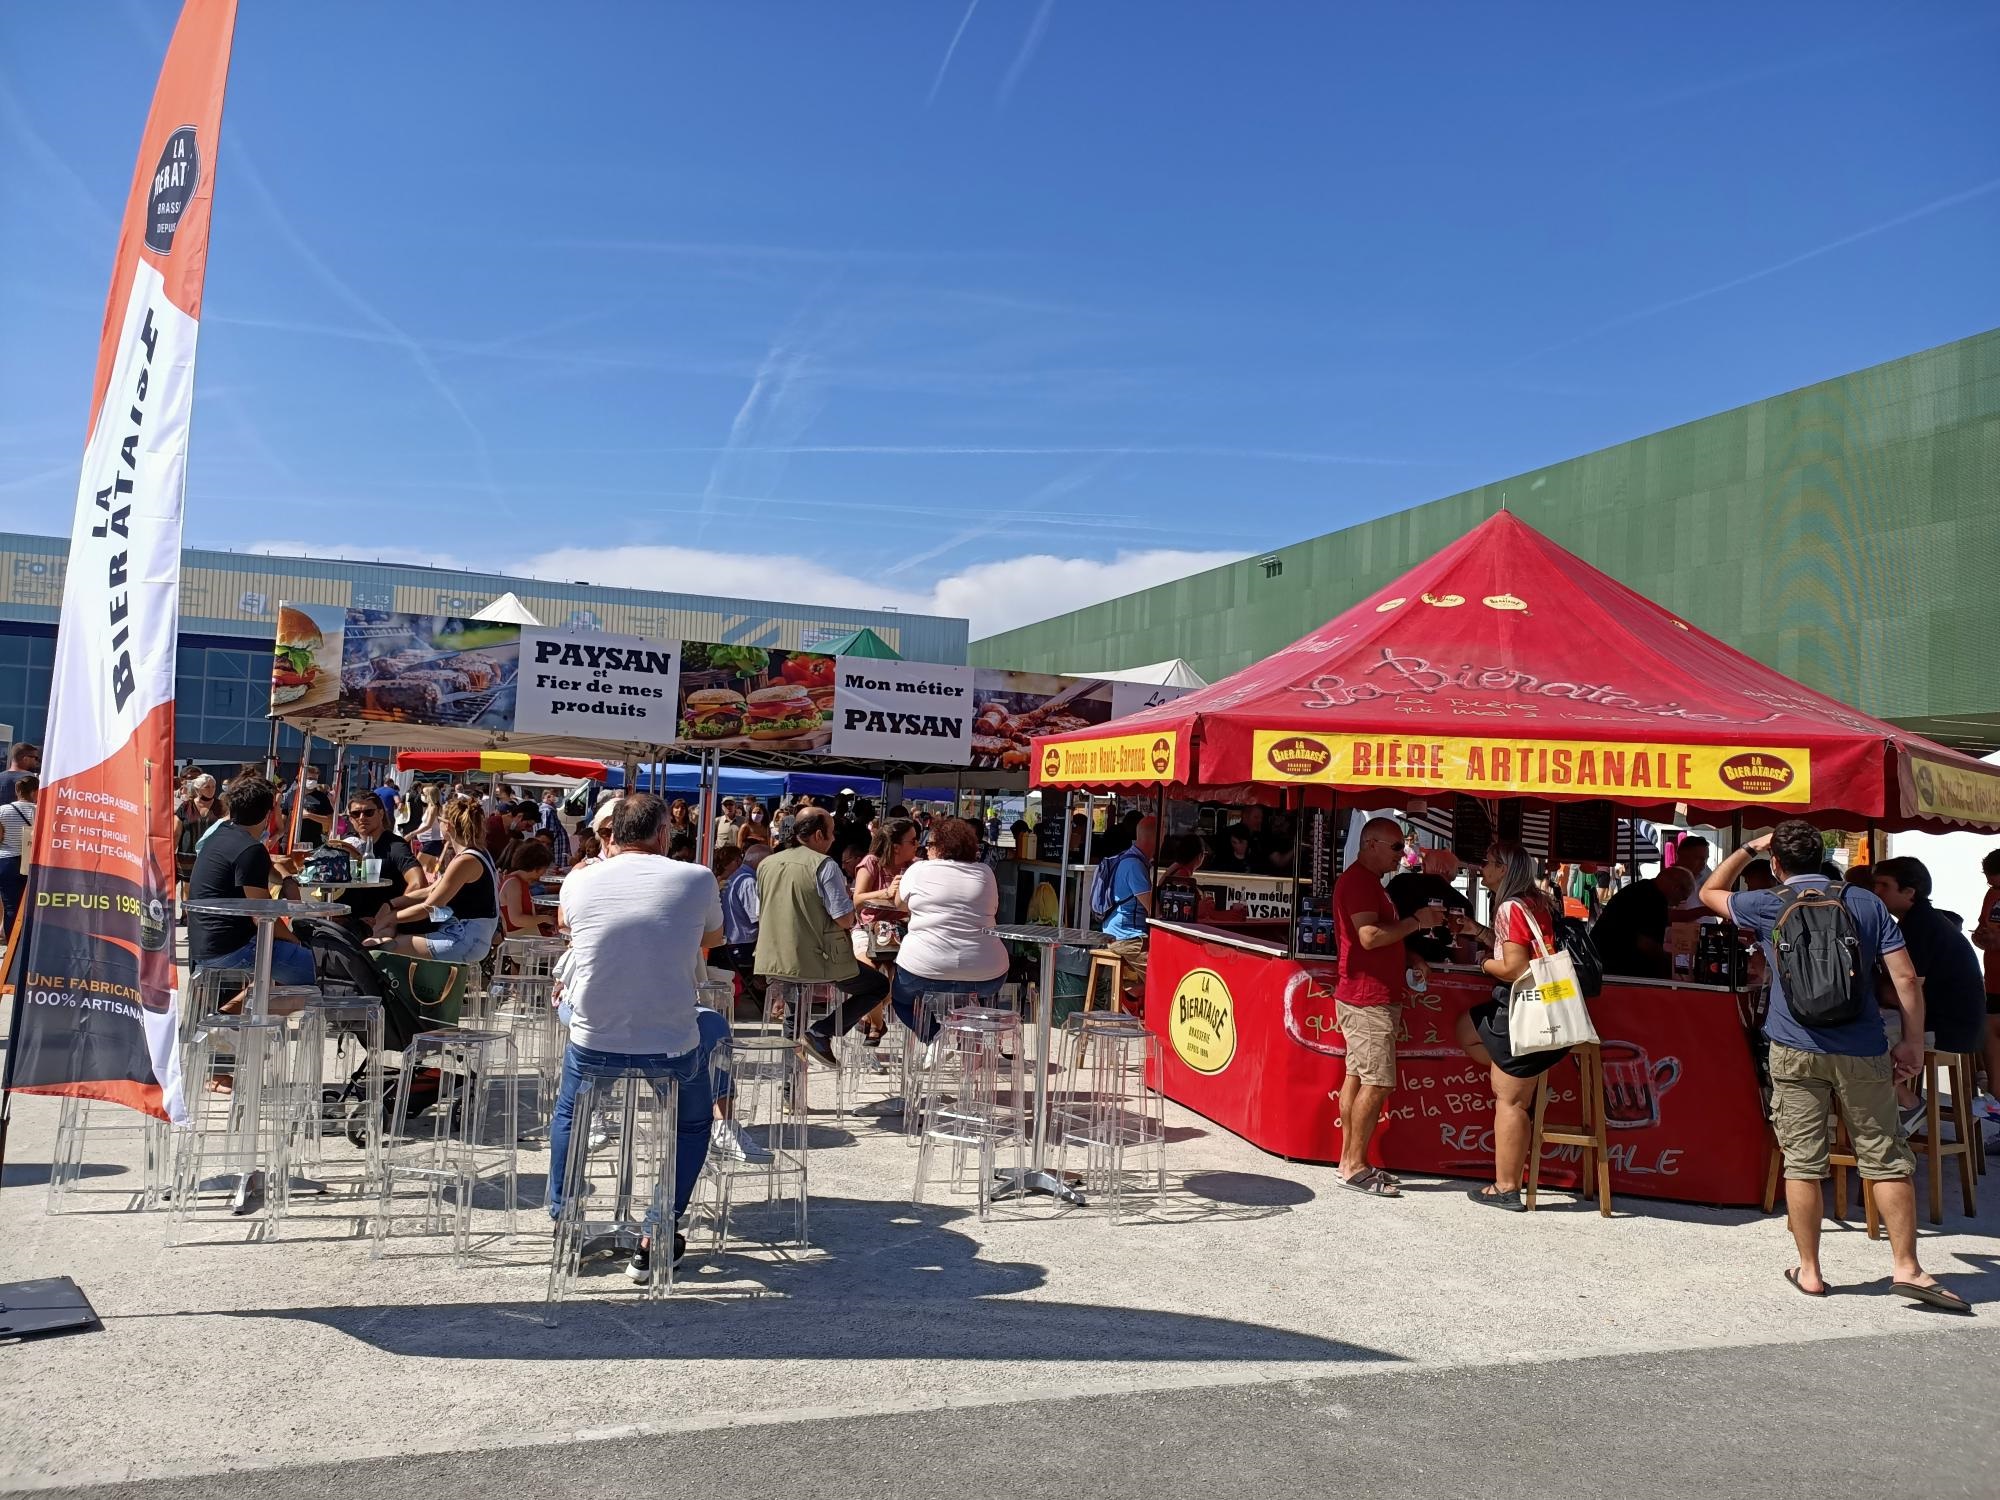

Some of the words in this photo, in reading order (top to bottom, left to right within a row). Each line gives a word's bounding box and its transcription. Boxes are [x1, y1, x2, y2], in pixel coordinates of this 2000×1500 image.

[172, 138, 185, 159] LA
[91, 485, 113, 538] LA
[535, 640, 671, 675] PAYSAN
[593, 669, 608, 678] et
[536, 674, 582, 691] Fier
[586, 680, 613, 694] de
[618, 684, 663, 698] mes
[845, 674, 891, 691] Mon
[896, 680, 964, 697] métier
[1287, 675, 1384, 709] La
[551, 701, 647, 718] produits
[844, 708, 963, 739] PAYSAN
[1295, 740, 1305, 749] LA
[1271, 748, 1329, 765] BIERATAISE
[1353, 739, 1444, 779] BIÈRE
[1465, 746, 1692, 790] ARTISANALE
[1751, 756, 1763, 766] LA
[1723, 765, 1791, 783] BIERATAISE
[55, 805, 116, 823] FAMILIALE
[51, 838, 72, 850] DE
[36, 892, 110, 910] DEPUIS
[115, 894, 141, 917] 1996
[26, 972, 64, 988] UNE
[1201, 976, 1210, 993] LA
[26, 990, 77, 1008] 100%
[1179, 994, 1228, 1041] BIERATAISE
[1401, 1069, 1436, 1091] les
[1420, 1095, 1442, 1117] la
